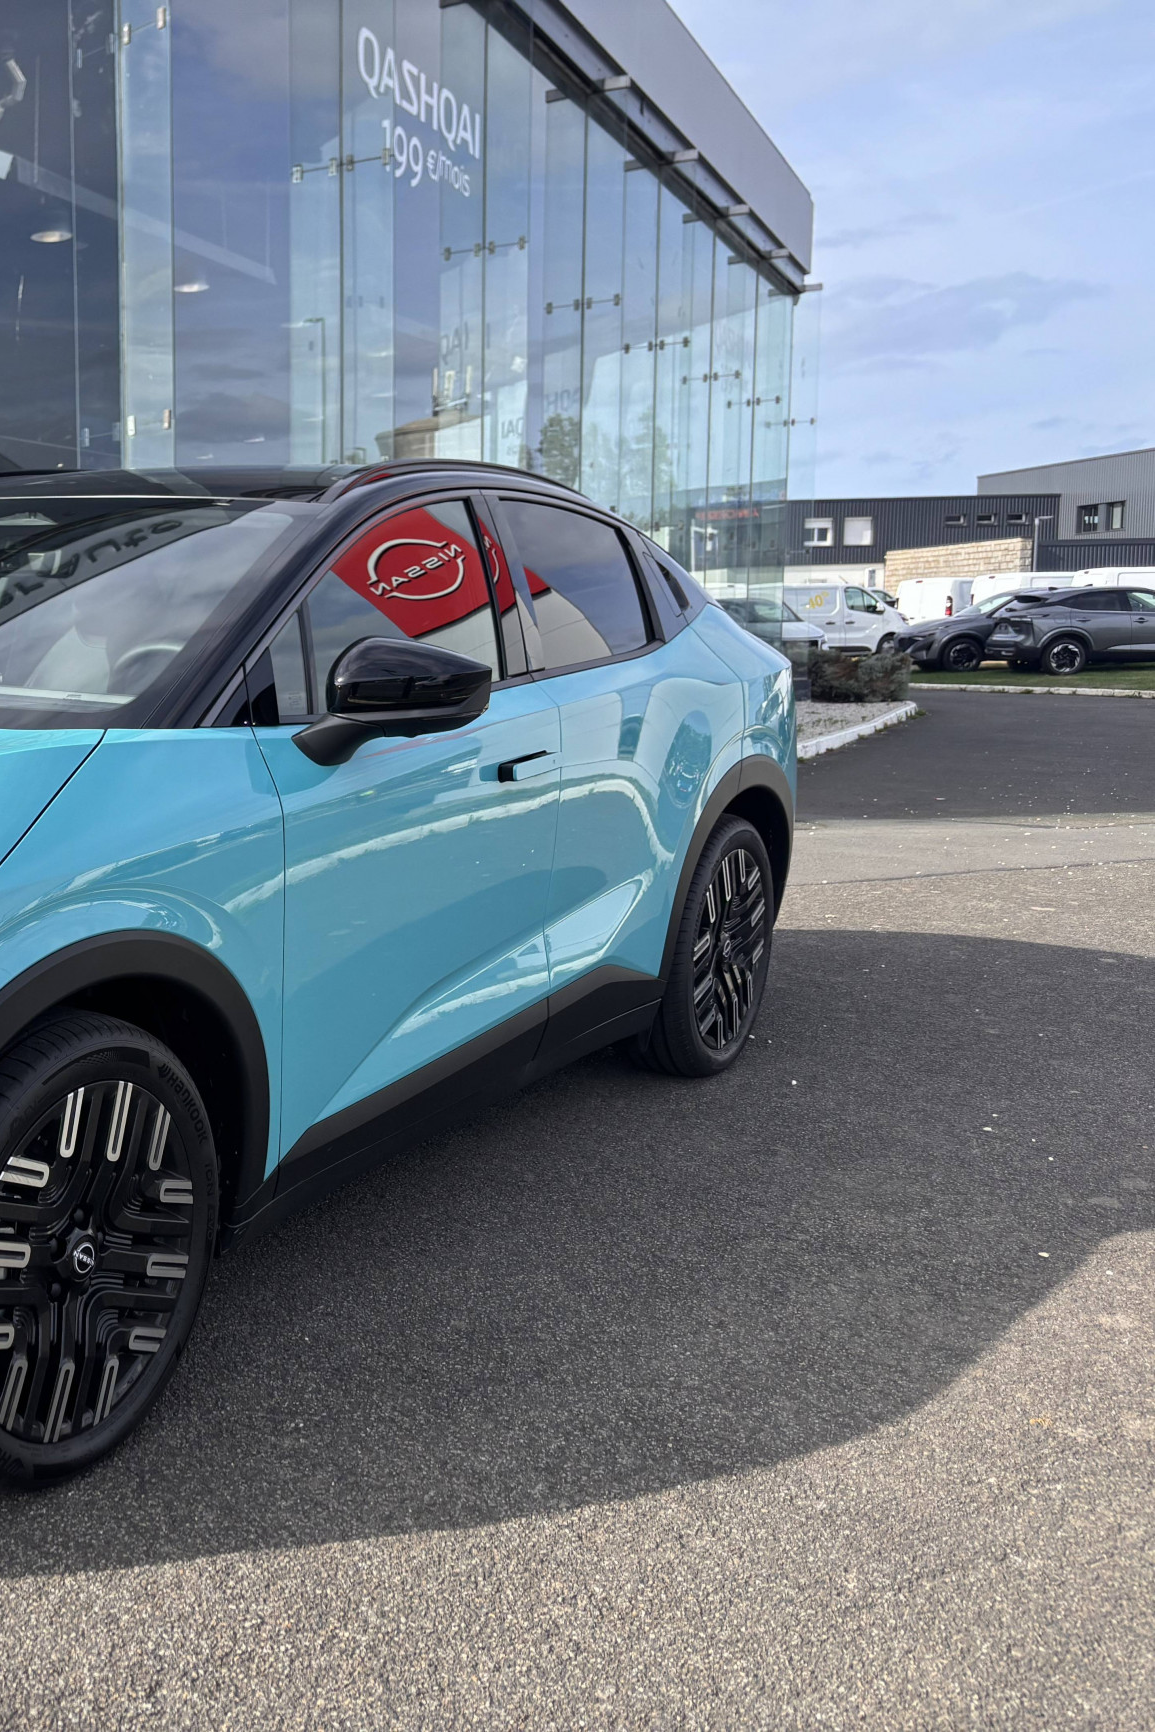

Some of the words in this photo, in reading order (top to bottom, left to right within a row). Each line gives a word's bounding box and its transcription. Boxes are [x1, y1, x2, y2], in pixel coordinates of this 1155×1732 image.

[357, 26, 481, 159] QASHQAI
[381, 119, 424, 187] 199
[426, 150, 471, 197] €/mois
[168, 1069, 208, 1144] Hankook
